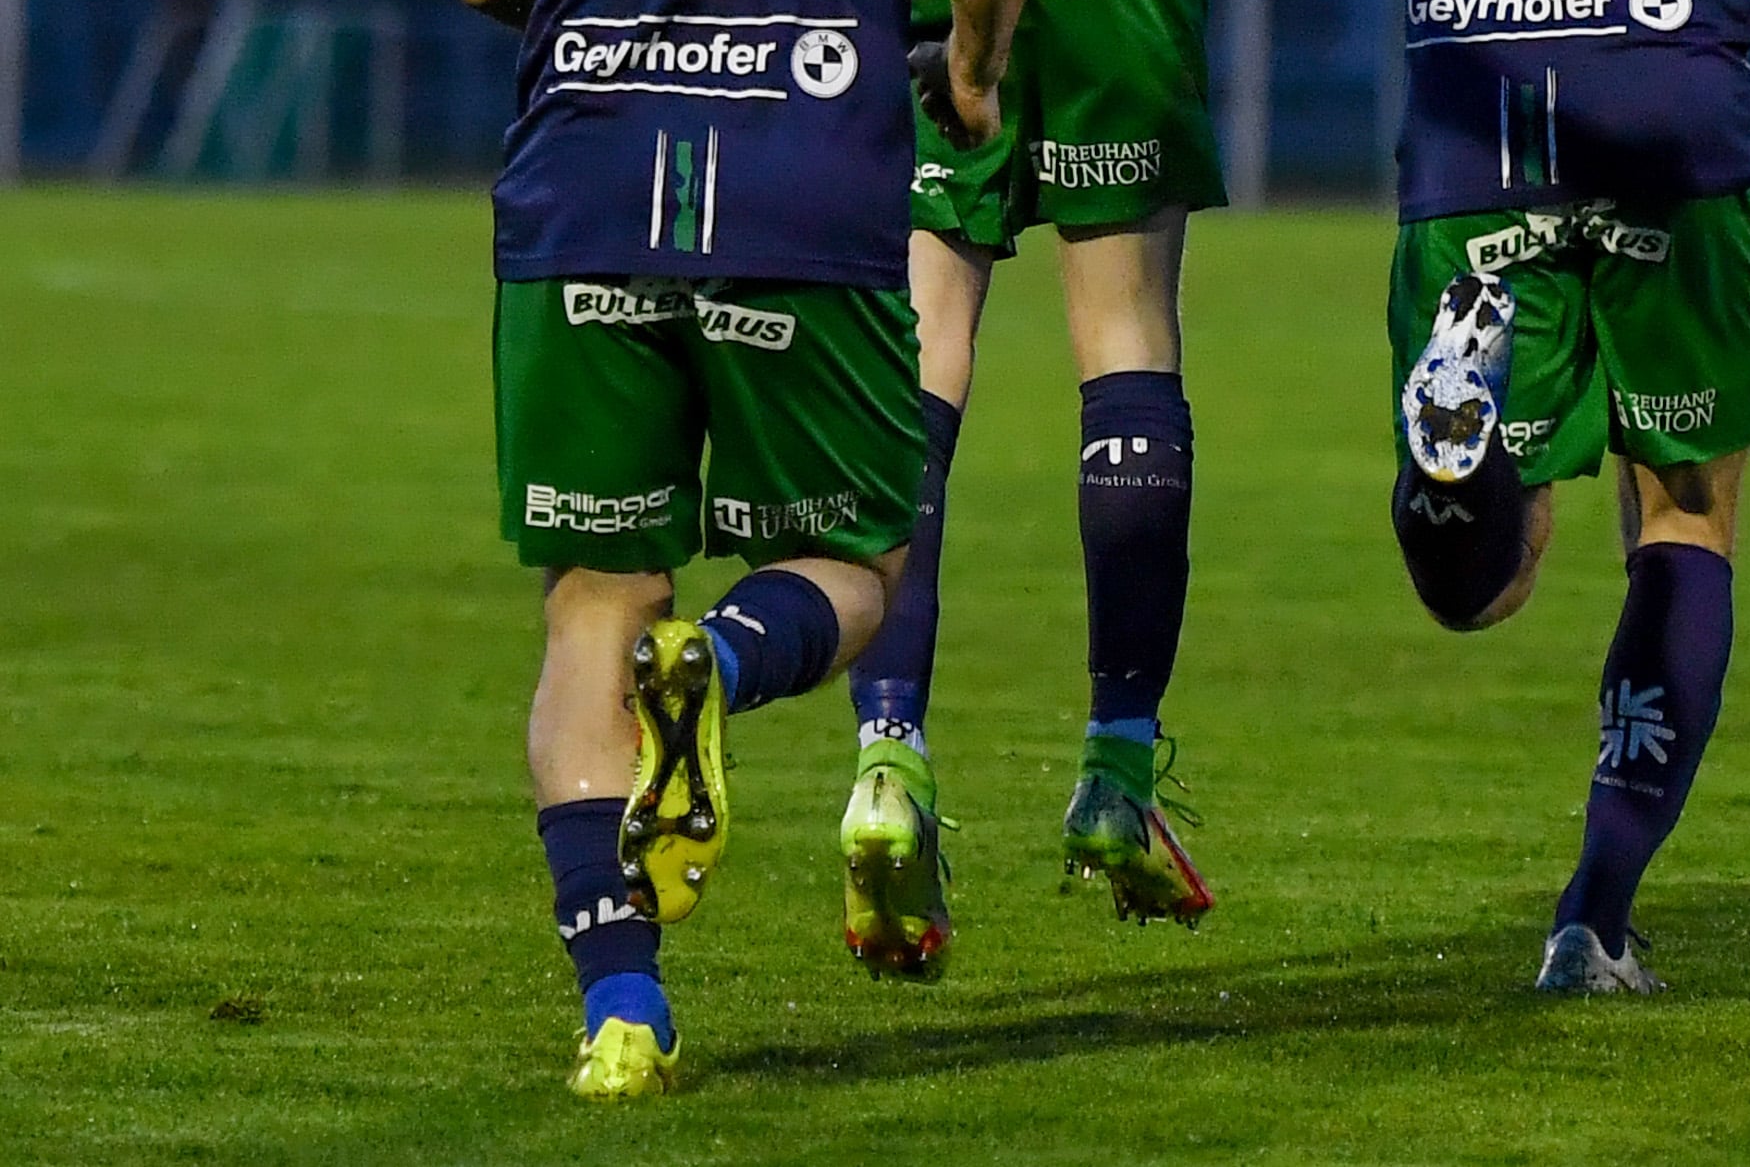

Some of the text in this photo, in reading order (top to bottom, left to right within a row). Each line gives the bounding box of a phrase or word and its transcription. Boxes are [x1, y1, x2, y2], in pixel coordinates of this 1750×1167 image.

[554, 32, 776, 77] Geyrhofer
[1058, 139, 1160, 162] TREUHAND
[1059, 154, 1161, 188] UNION
[1627, 389, 1716, 410] REUHAND
[525, 505, 637, 534] Druck
